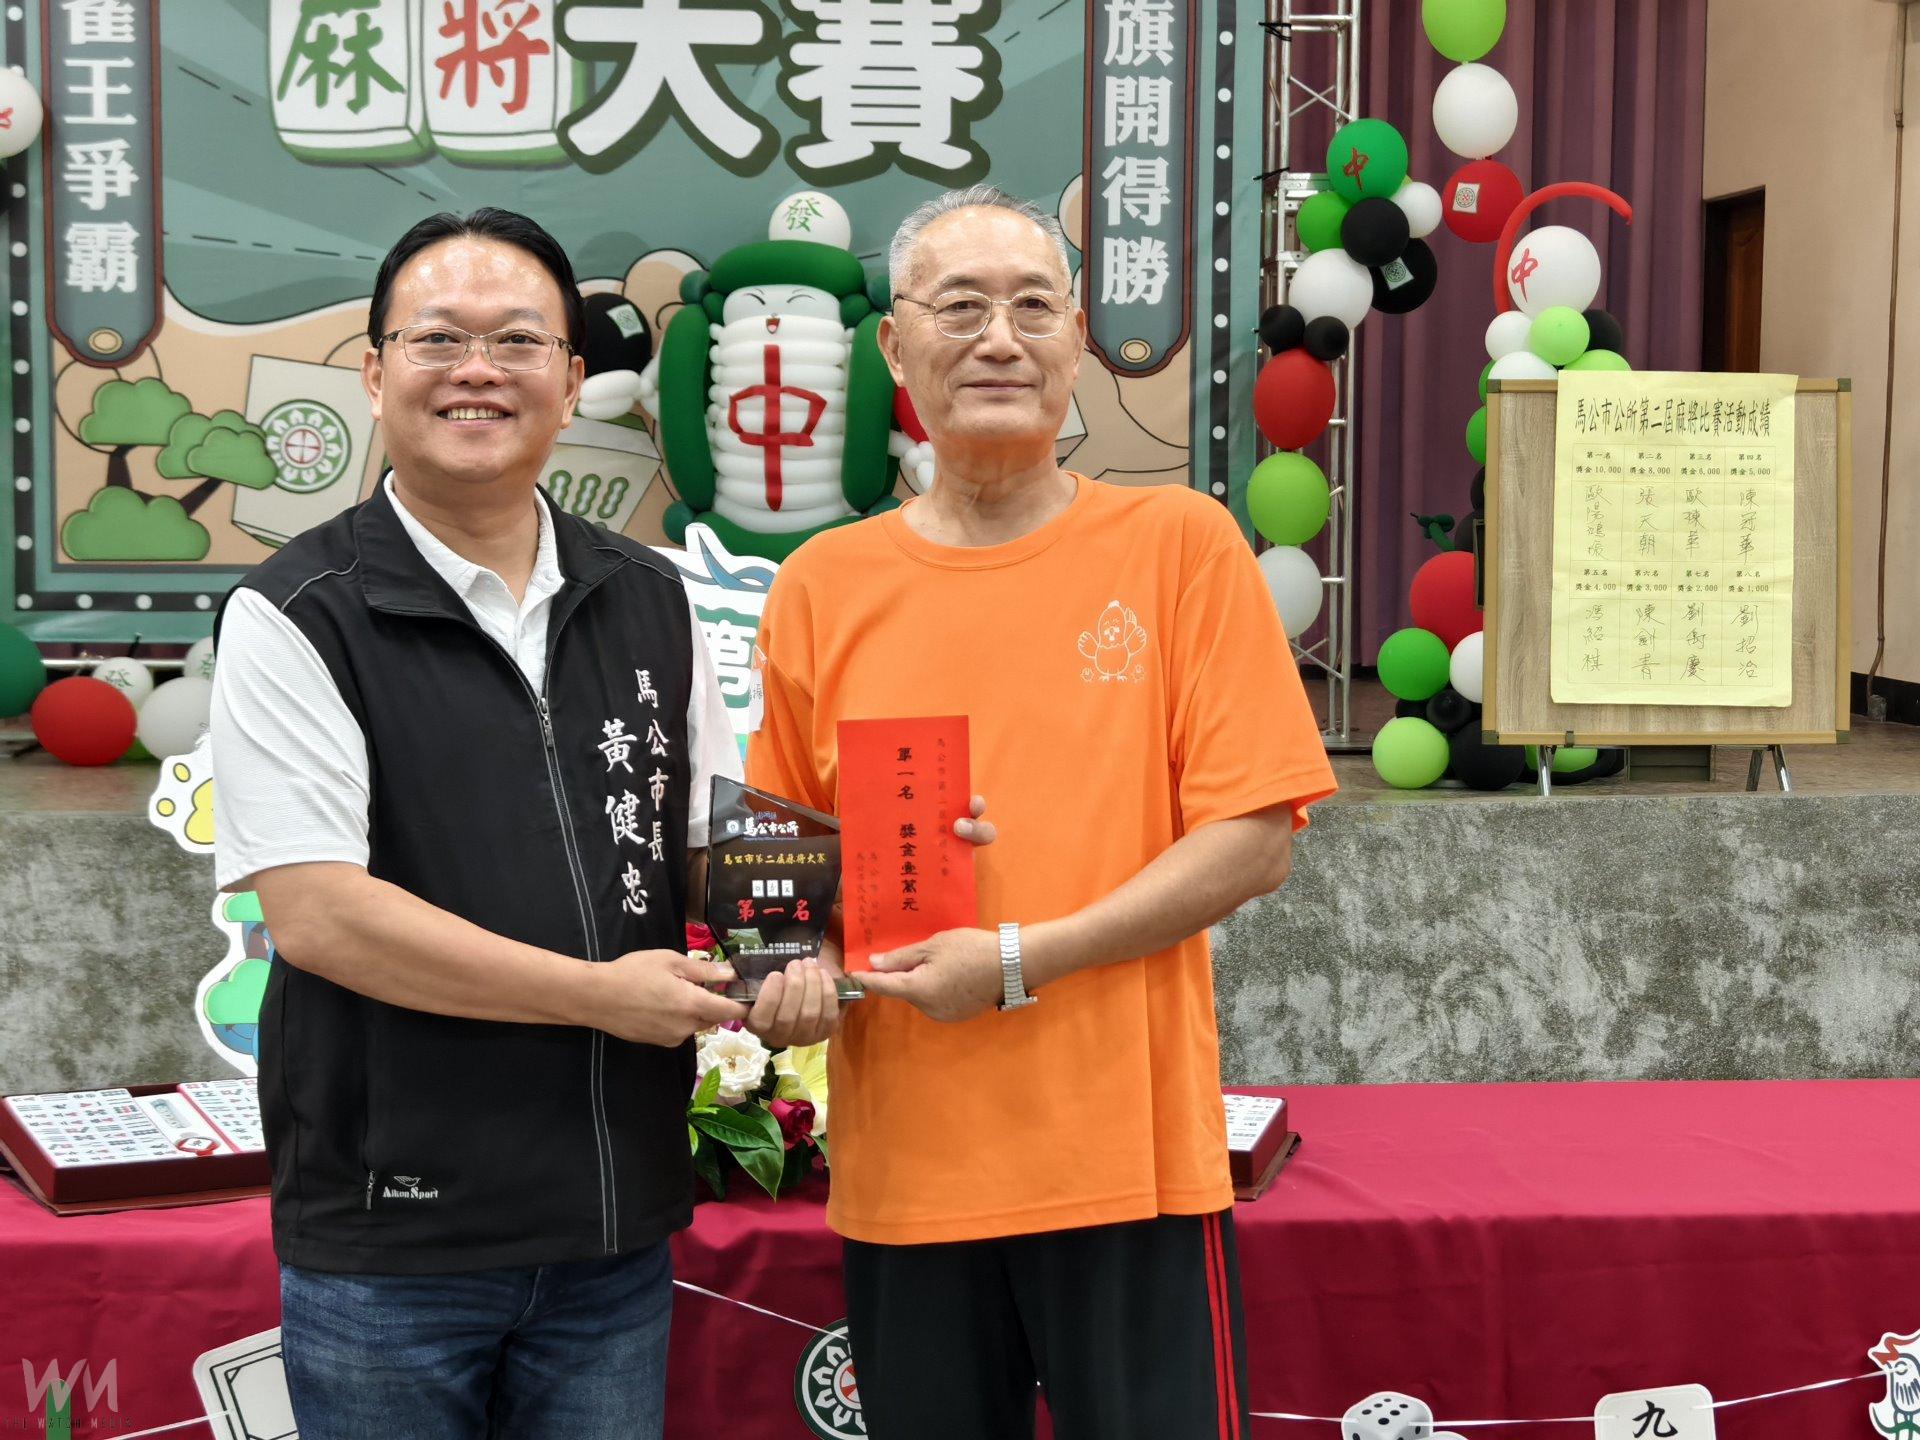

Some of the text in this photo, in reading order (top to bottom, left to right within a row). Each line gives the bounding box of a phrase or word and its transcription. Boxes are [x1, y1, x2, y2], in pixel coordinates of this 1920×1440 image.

[62, 0, 140, 292] 雀王爭霸
[1101, 0, 1175, 305] 旗開得勝
[1343, 147, 1369, 192] 中
[785, 197, 824, 232] 發
[1512, 248, 1540, 302] 中
[729, 344, 828, 512] 中
[1575, 396, 1770, 437] 馬公市公所第二屆麻將比賽活動成績
[1587, 451, 1611, 459] 第一名
[1638, 452, 1662, 460] 第二名
[1689, 452, 1712, 461] 第三名
[1738, 453, 1762, 461] 第四名
[1583, 568, 1608, 576] 第五名
[1634, 569, 1659, 577] 第六名
[1686, 569, 1710, 578] 第七名
[1736, 570, 1761, 578] 第八名
[635, 669, 670, 862] 馬公市長
[597, 717, 649, 915] 黃健忠
[743, 816, 799, 837] 馬公市公所
[897, 747, 919, 911] 第一名 獎金壹萬元
[737, 899, 811, 922] 第一名
[411, 1186, 439, 1200] Sport
[1632, 1400, 1678, 1438] 九
